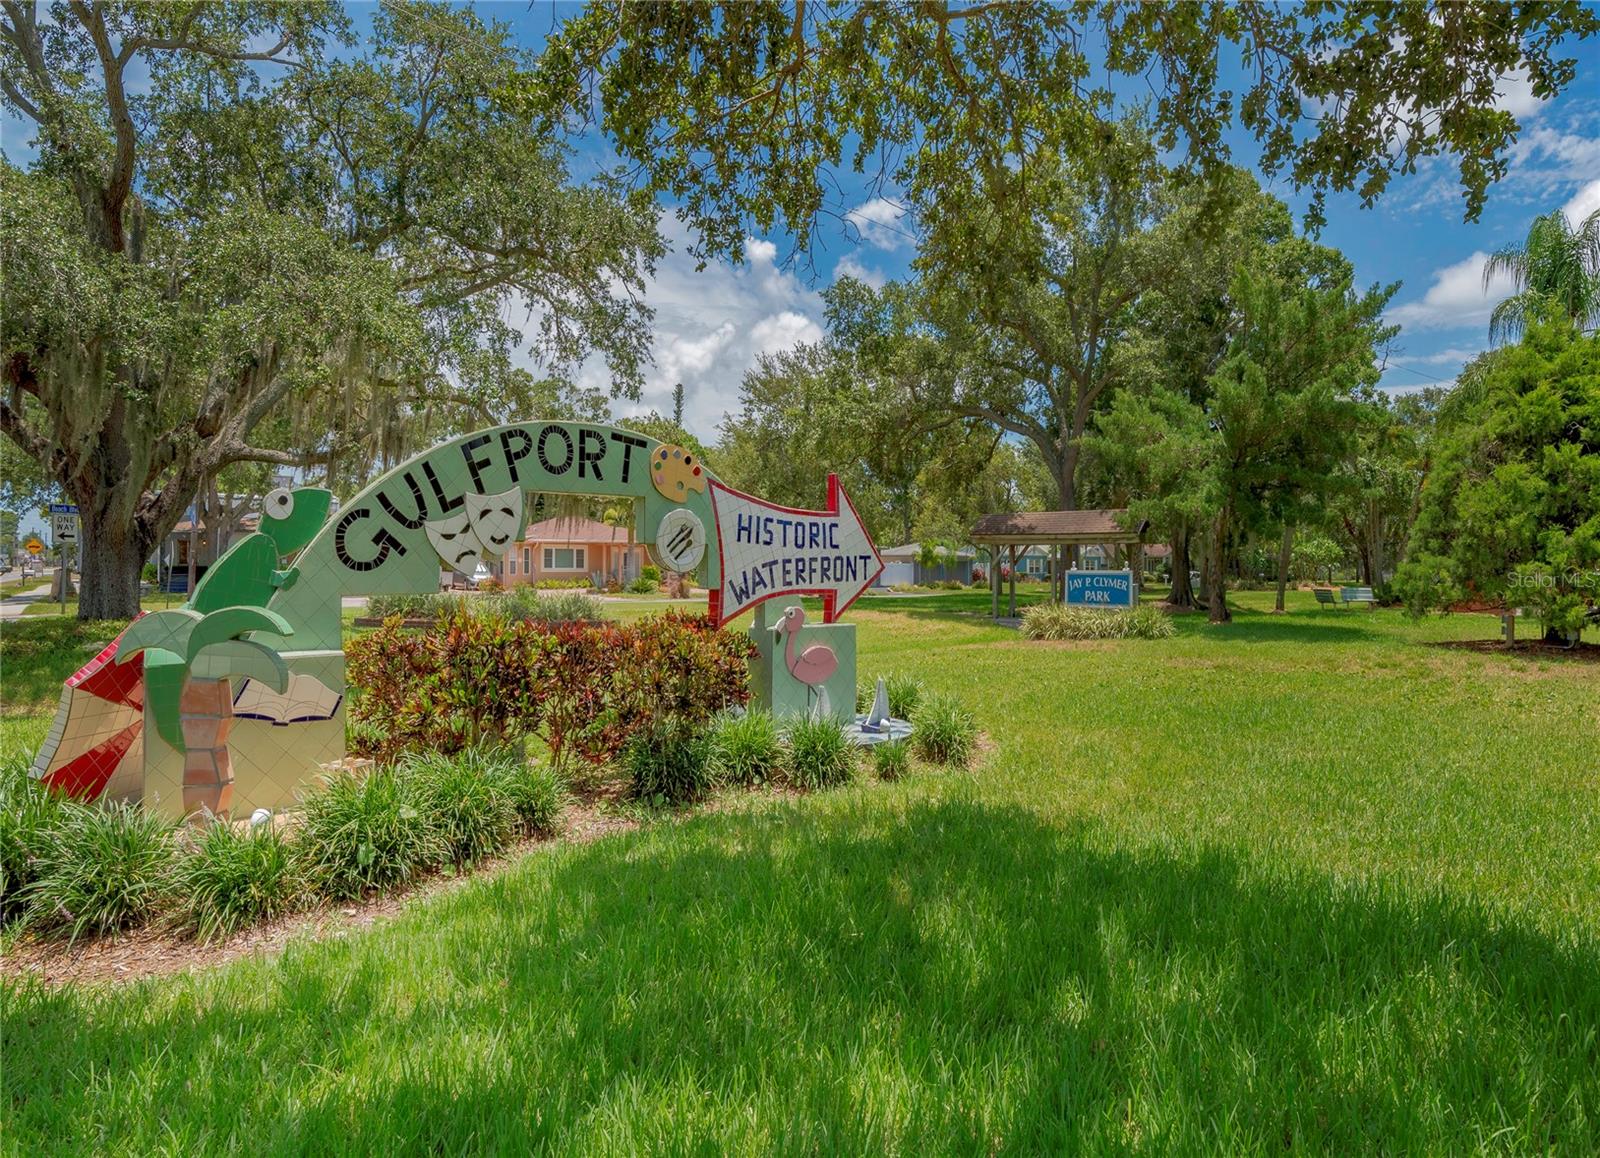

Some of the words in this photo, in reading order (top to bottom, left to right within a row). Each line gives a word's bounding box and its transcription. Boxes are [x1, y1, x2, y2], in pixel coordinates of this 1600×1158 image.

[335, 425, 648, 571] GULFPORT
[57, 516, 75, 524] ONE
[736, 513, 840, 550] HISTORIC
[728, 555, 871, 605] WATERFRONT
[1069, 578, 1083, 591] JAY
[1093, 576, 1128, 591] CLYMER
[1085, 591, 1110, 602] PARK
